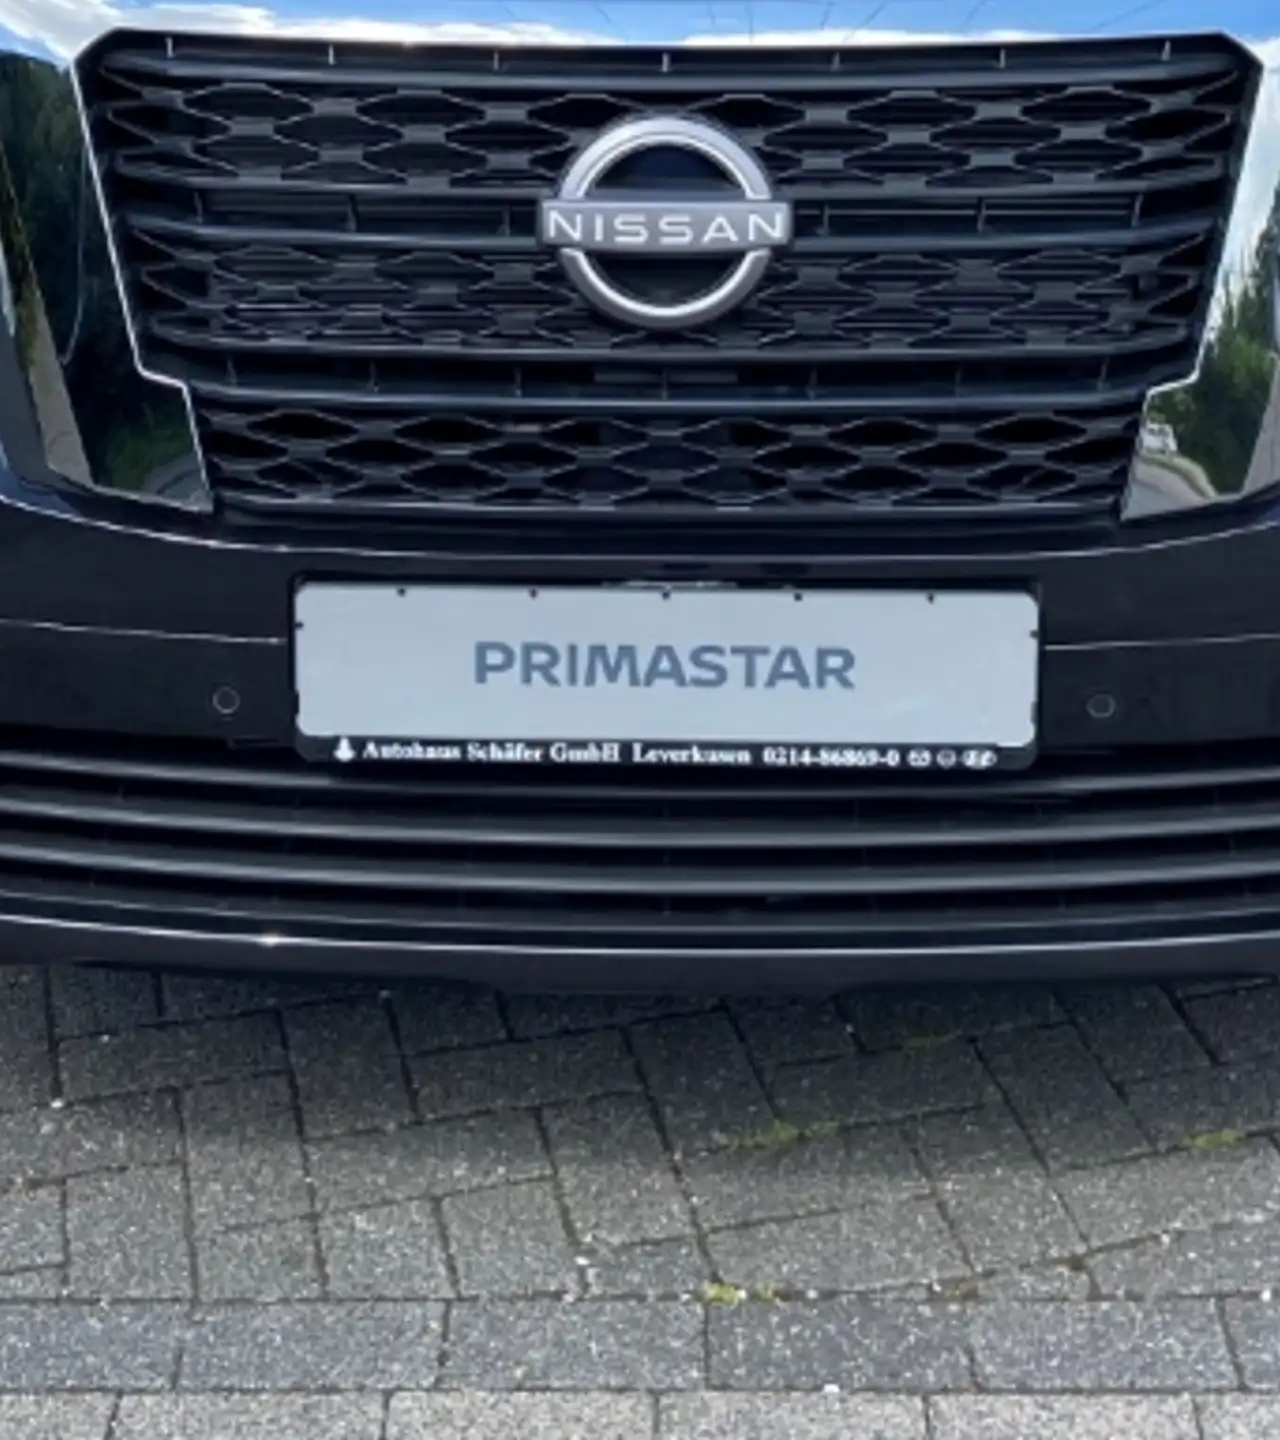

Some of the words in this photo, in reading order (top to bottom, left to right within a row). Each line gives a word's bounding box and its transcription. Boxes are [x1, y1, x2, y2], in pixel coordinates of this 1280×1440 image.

[548, 210, 783, 245] NISSAN
[474, 641, 856, 689] PRIMASTAR
[362, 742, 462, 760] Autohaus
[467, 742, 542, 762] Schäfer
[549, 742, 620, 763] GmbH
[632, 742, 752, 765] Leverkusen
